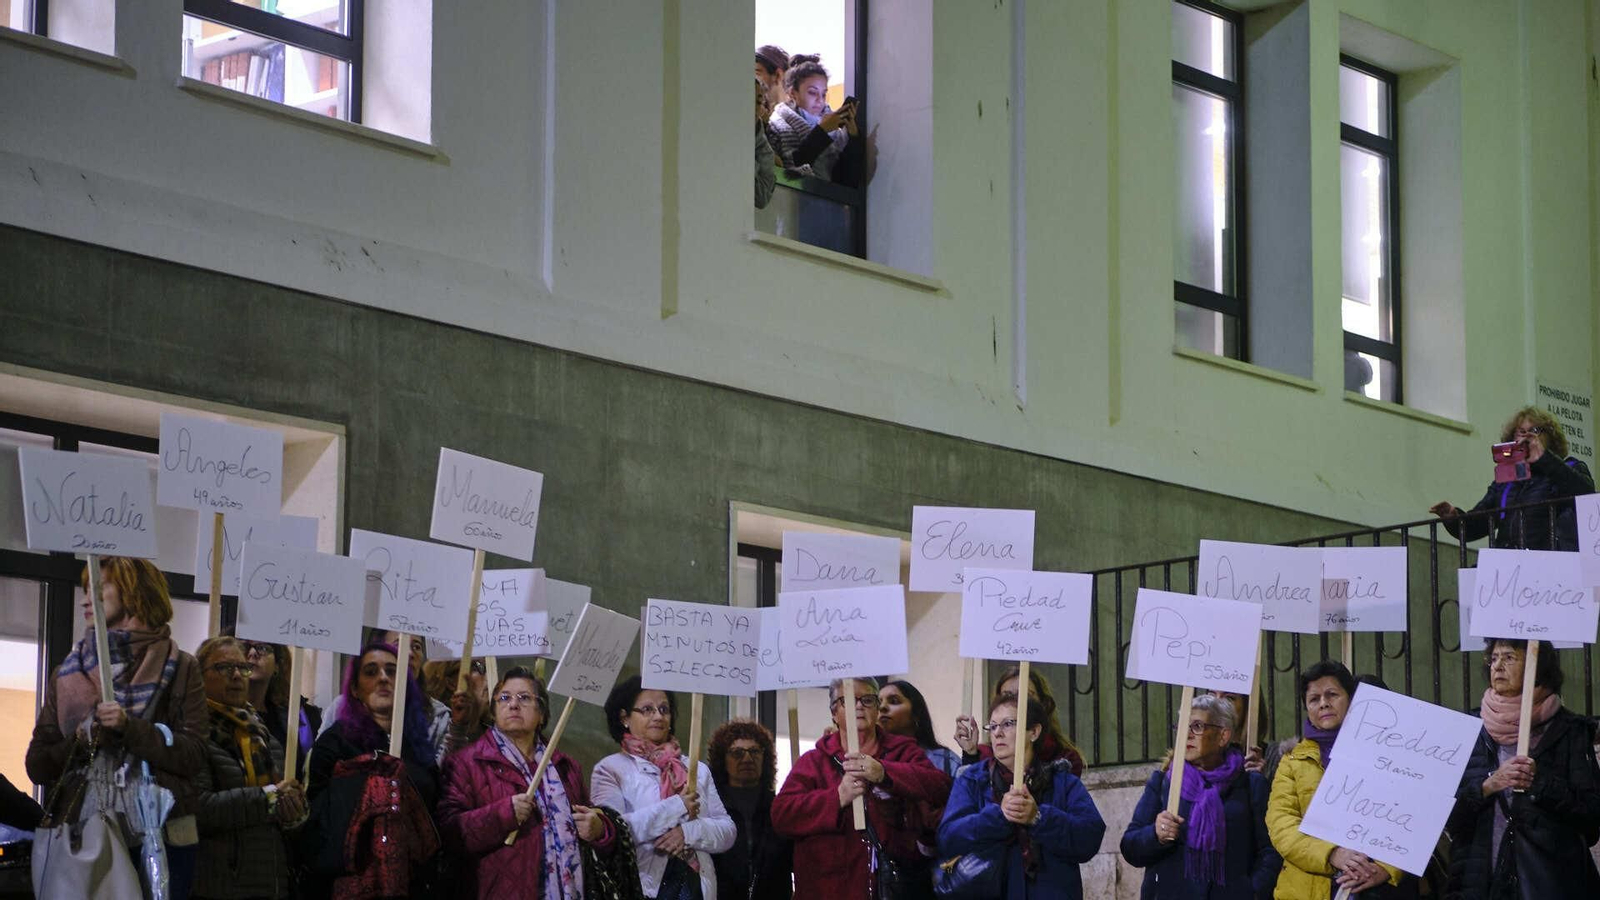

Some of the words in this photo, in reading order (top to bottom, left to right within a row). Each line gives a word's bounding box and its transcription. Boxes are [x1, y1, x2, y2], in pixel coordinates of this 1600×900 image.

[1539, 385, 1571, 401] PROHIBIDO
[1571, 394, 1591, 409] JUGAR
[1552, 405, 1560, 415] LA
[1560, 408, 1583, 422] PELOTA
[164, 427, 272, 488] Angeles
[1571, 441, 1580, 454] DE
[1580, 445, 1593, 457] LOS
[32, 471, 147, 532] Natalia
[440, 464, 535, 529] Manuela
[921, 519, 1017, 560] Elena
[364, 546, 444, 609] Rita
[789, 547, 884, 584] Dana
[1205, 555, 1313, 603] Andrea
[1321, 561, 1387, 600] aria
[968, 576, 1066, 609] Piedad
[647, 604, 713, 628] BASTA
[724, 612, 751, 636] YA
[795, 595, 869, 629] Ana
[646, 632, 737, 655] MINUTOS
[741, 642, 759, 658] DE
[1140, 606, 1217, 669] Pepi
[648, 653, 753, 686] SILECIOS
[1352, 699, 1463, 766] Piedad
